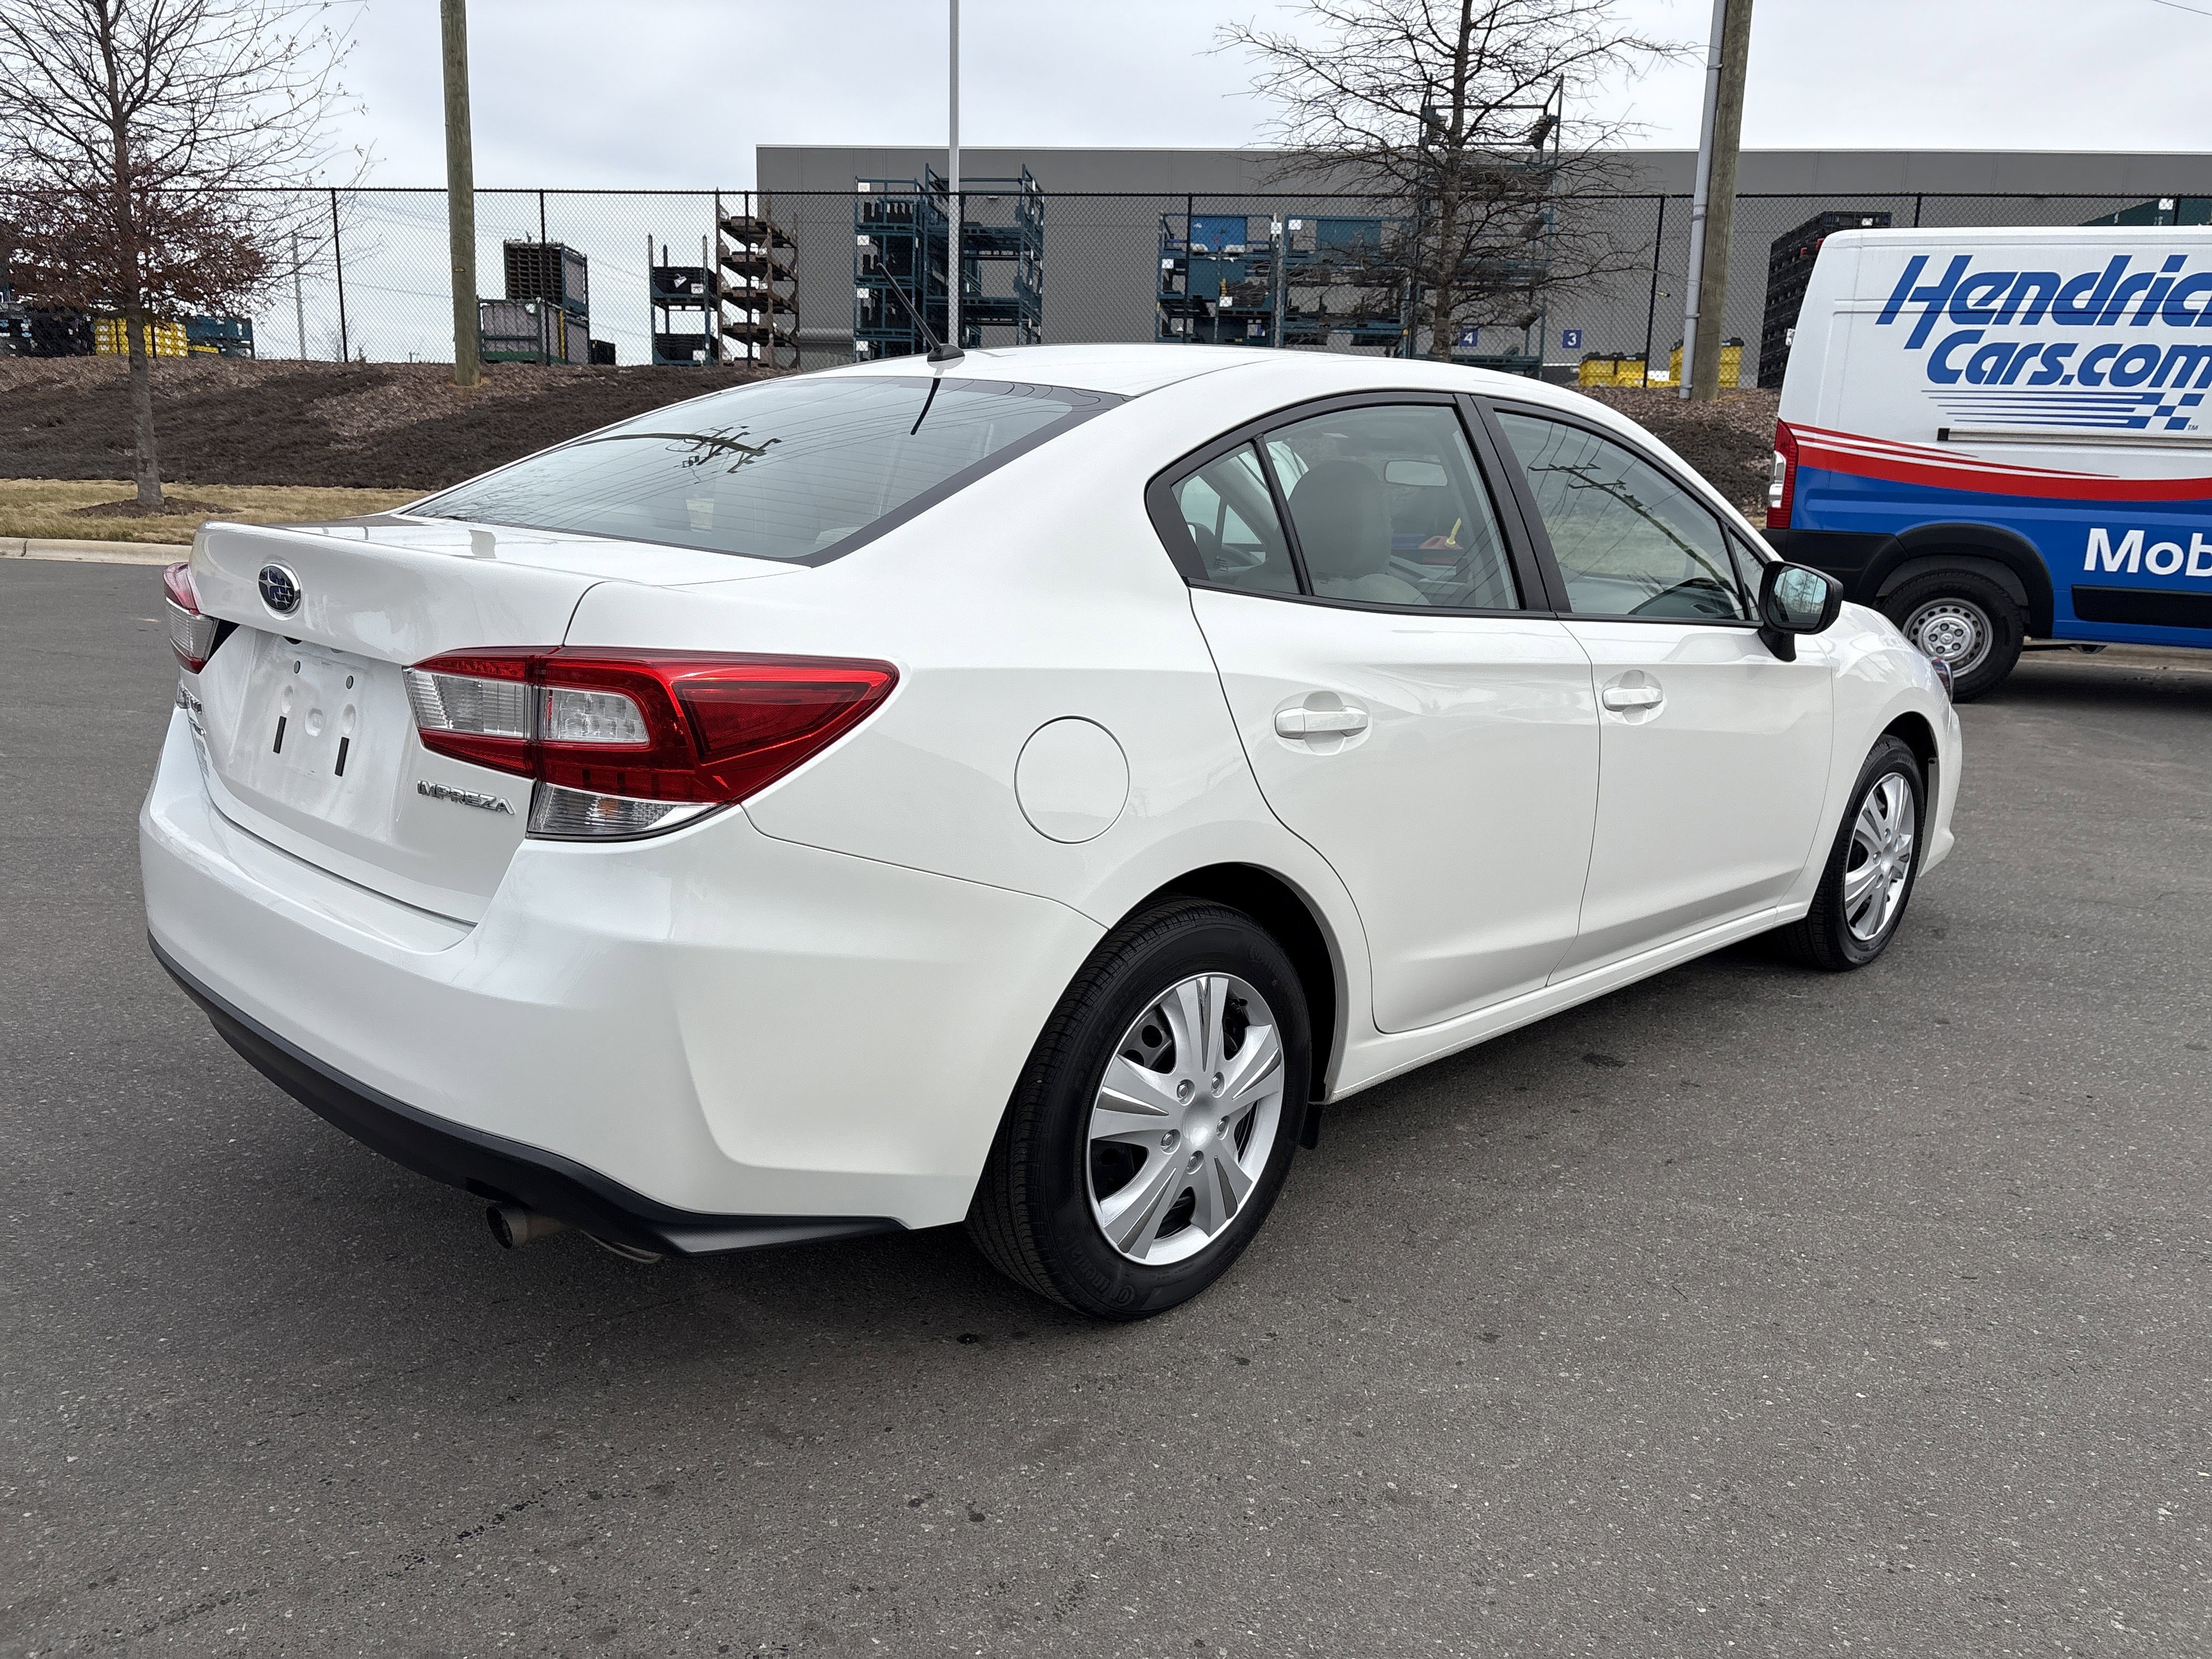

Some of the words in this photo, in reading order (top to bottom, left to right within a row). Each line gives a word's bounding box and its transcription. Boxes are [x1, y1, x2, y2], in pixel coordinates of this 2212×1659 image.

[1464, 332, 1473, 344] 4
[1567, 332, 1577, 346] 3
[1927, 329, 2212, 387] Cars.com
[2084, 527, 2212, 577] Mob
[417, 780, 516, 815] IMPREZA
